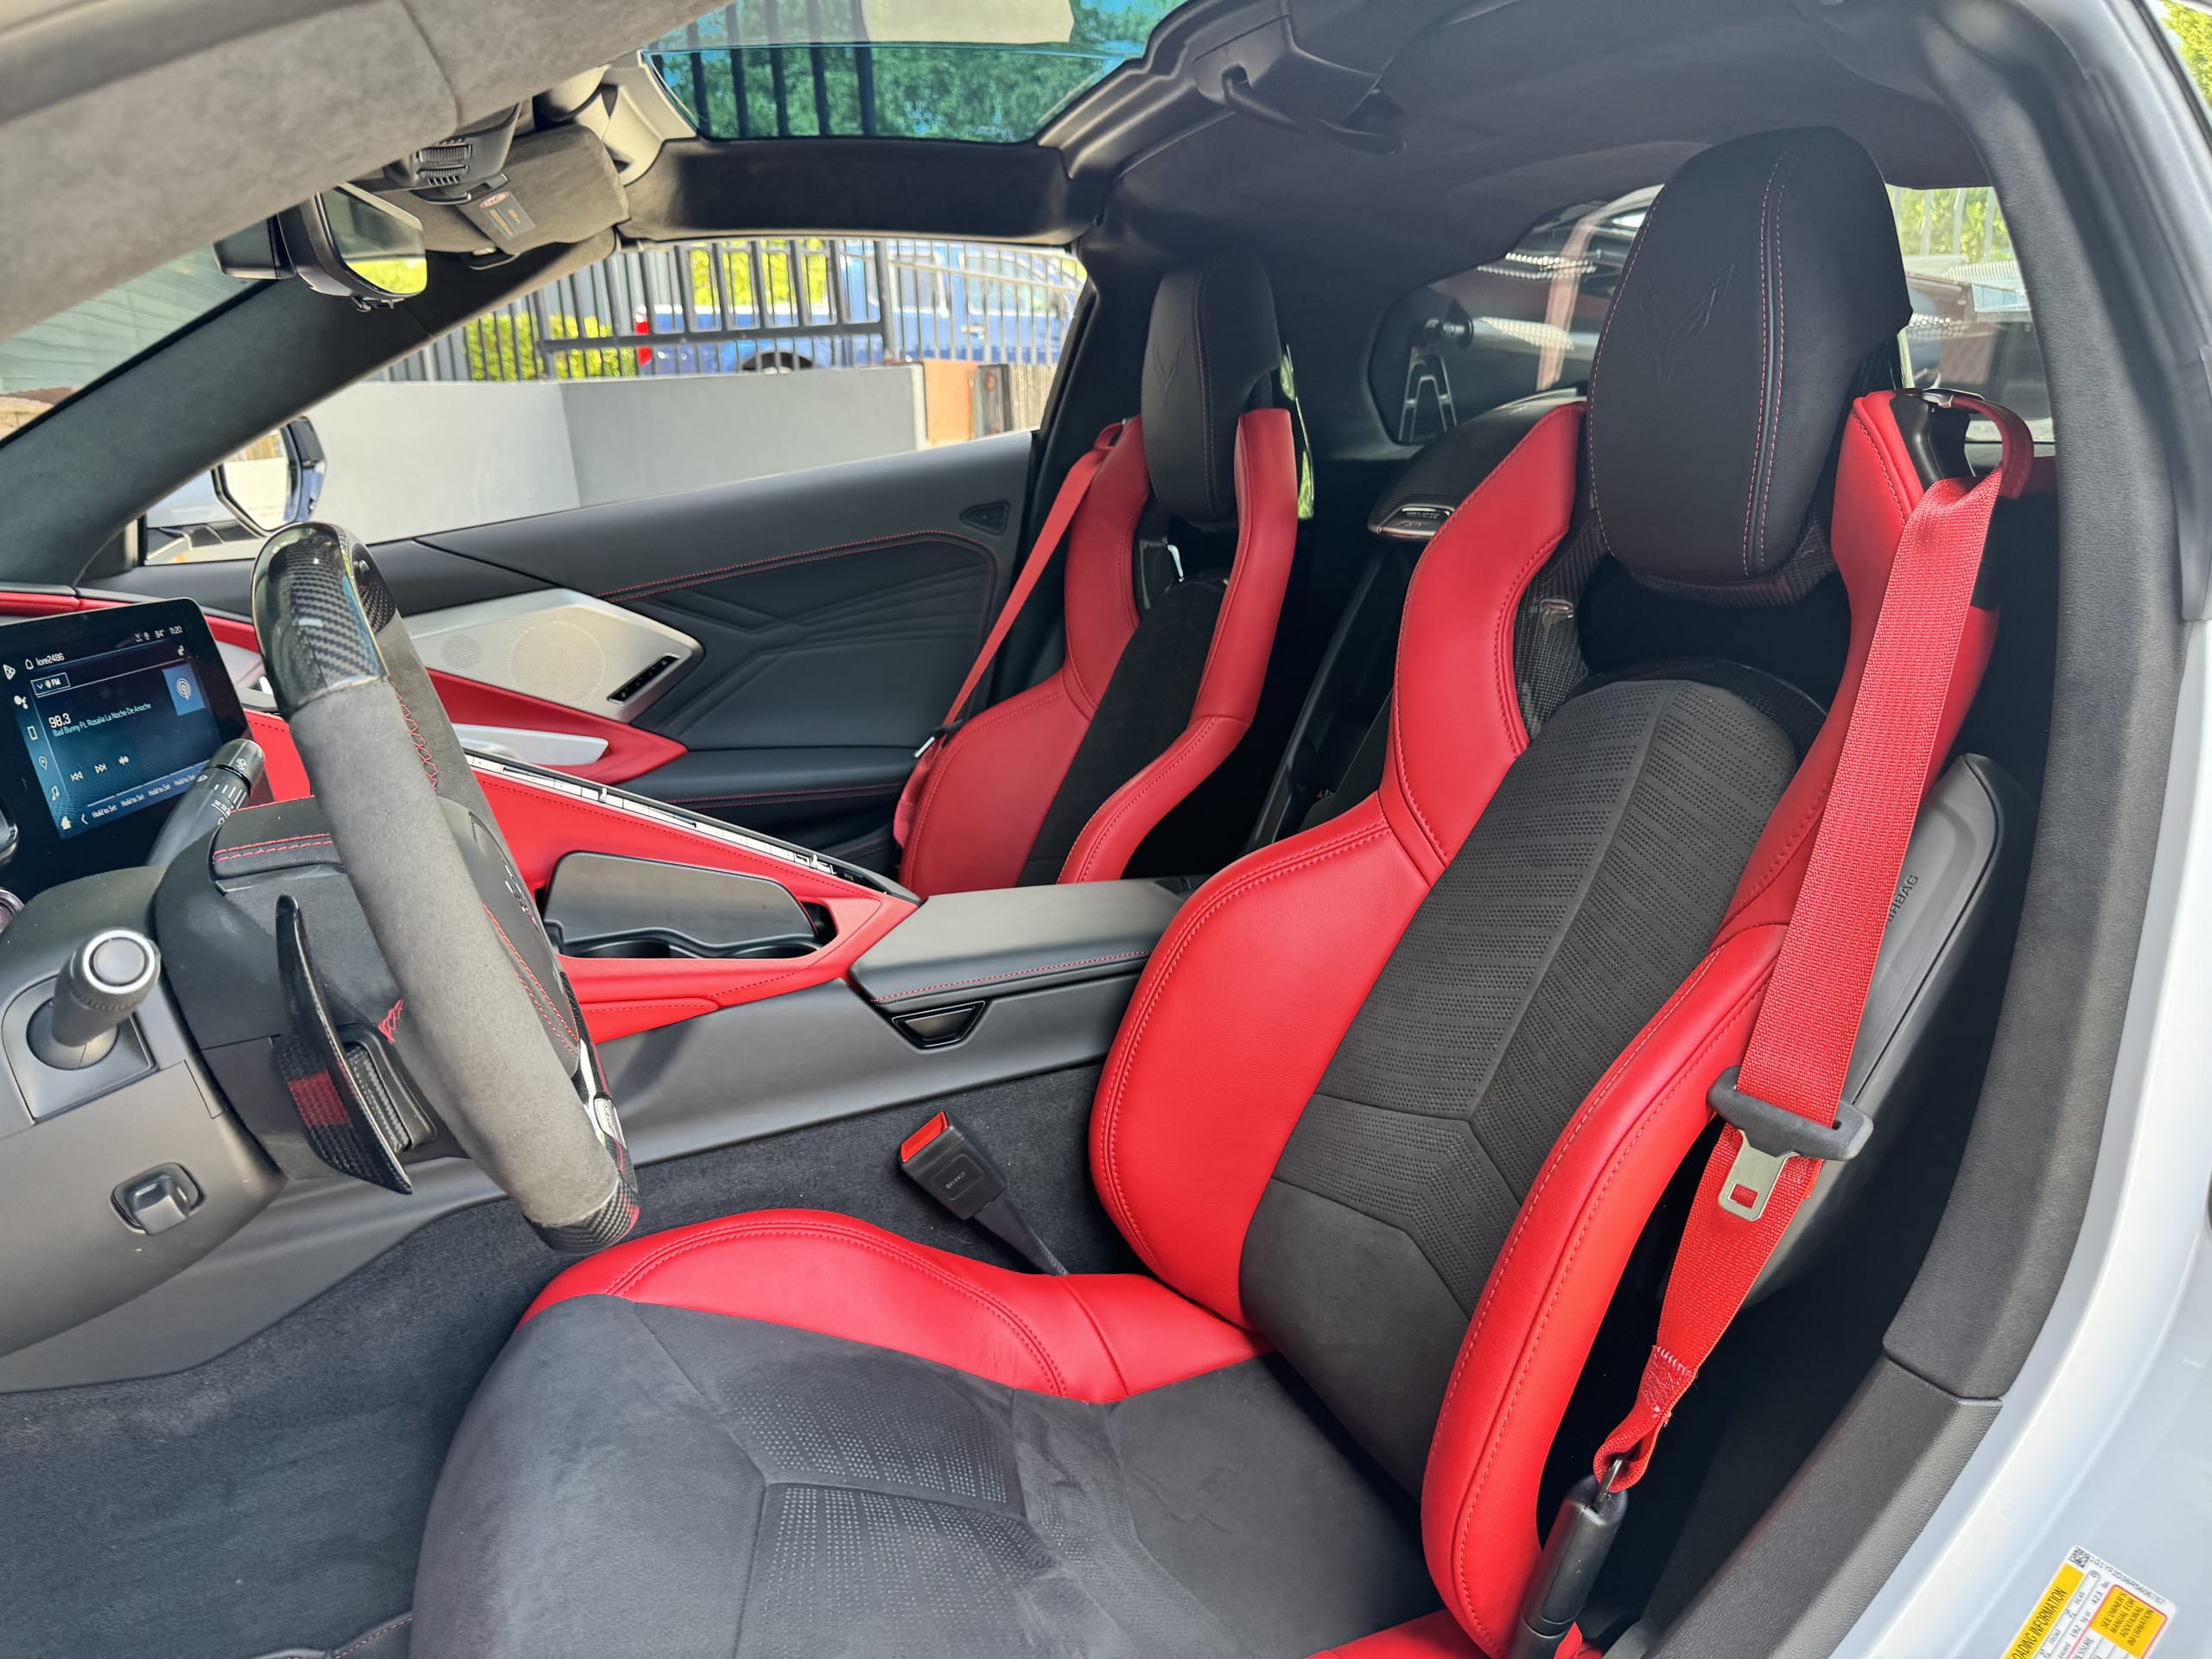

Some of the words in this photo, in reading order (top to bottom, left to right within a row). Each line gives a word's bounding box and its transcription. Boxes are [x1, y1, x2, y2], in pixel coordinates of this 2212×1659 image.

[51, 678, 61, 687] FM
[48, 713, 71, 728] 98.3
[53, 728, 65, 737] Bad
[64, 725, 80, 734] Bunny
[111, 710, 127, 719] Noche
[133, 702, 151, 712] Anoche
[92, 809, 105, 818] Hold
[120, 798, 132, 807] Hold
[1888, 874, 1918, 922] IRBAG
[2012, 1632, 2037, 1659] OADING
[2029, 1586, 2068, 1637] INFORMATION
[2101, 1617, 2112, 1629] SEE
[2109, 1611, 2128, 1634] MANUAL
[2123, 1598, 2136, 1611] FOR
[2119, 1605, 2144, 1639] ADDITIONAL
[2127, 1609, 2154, 1647] INFORMATION
